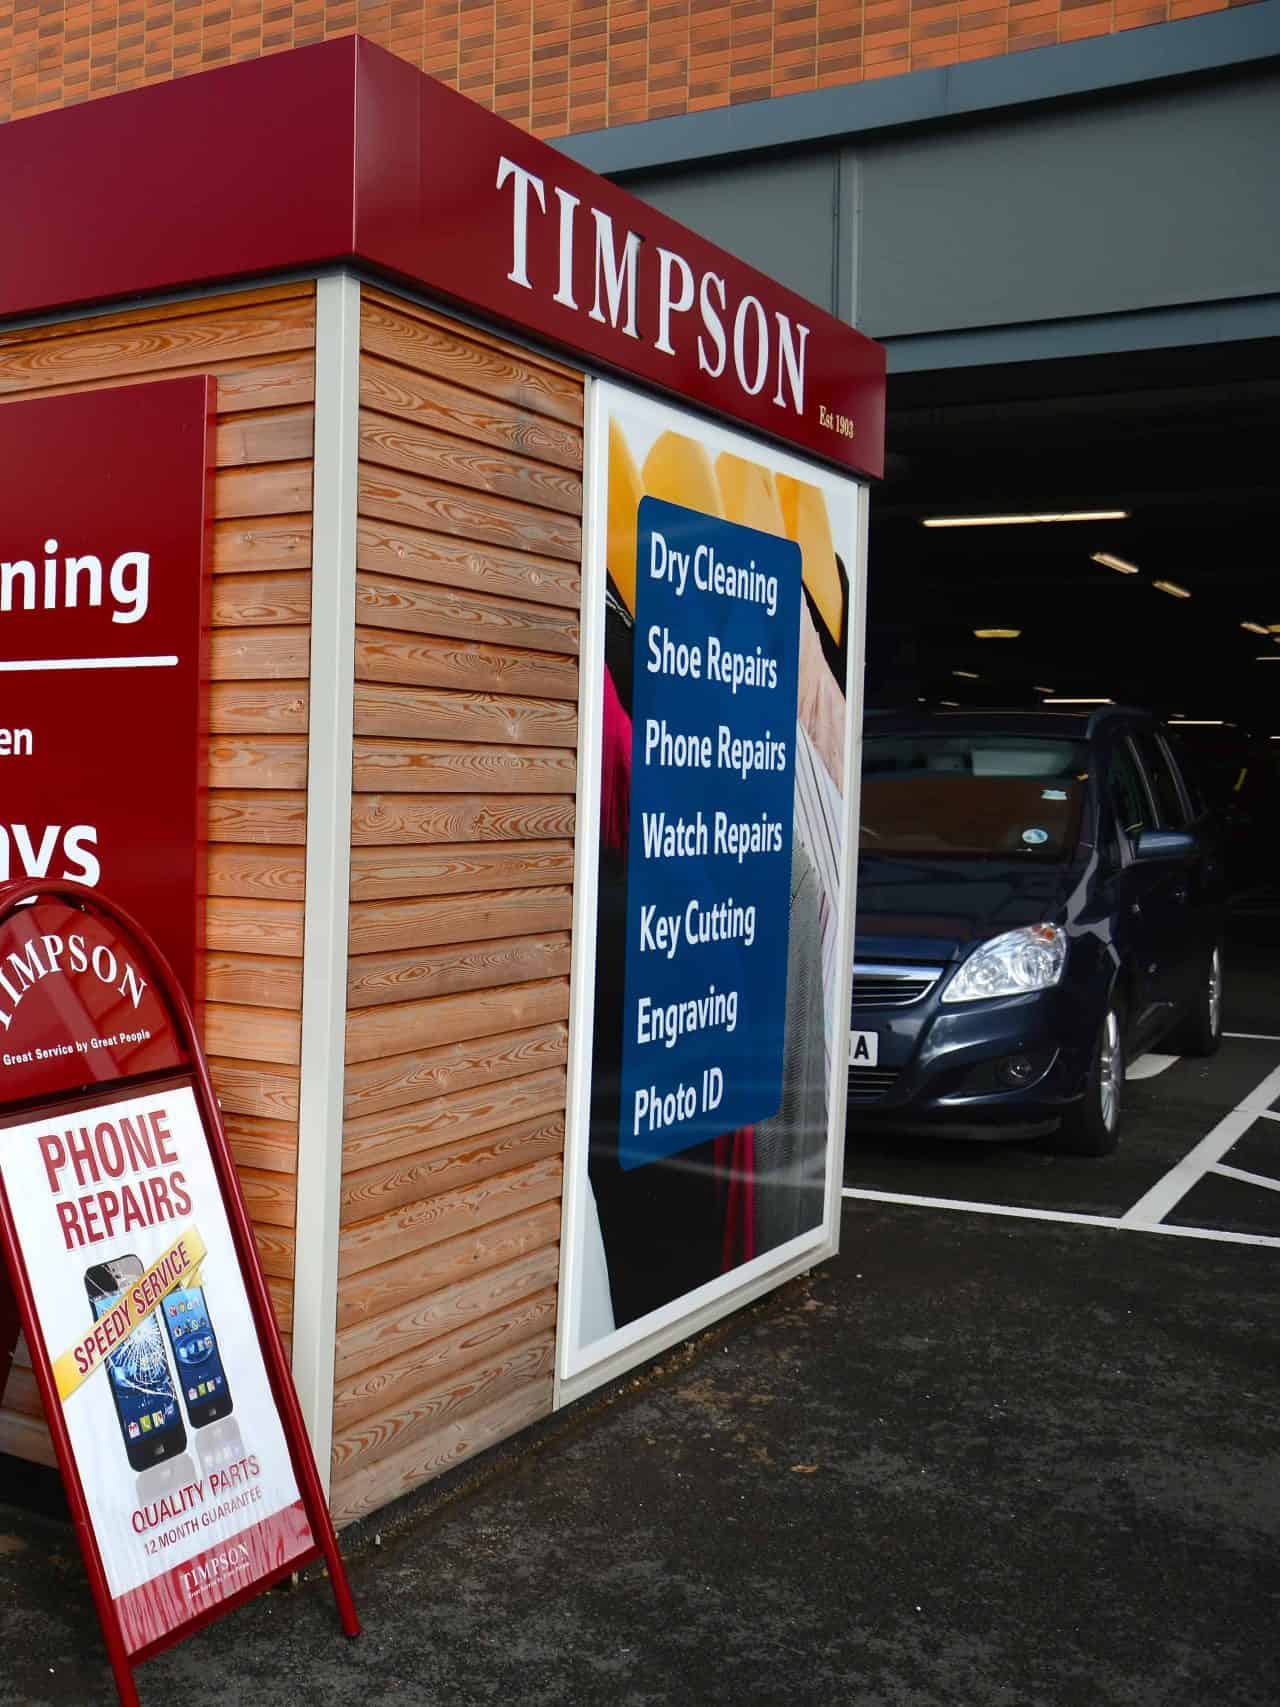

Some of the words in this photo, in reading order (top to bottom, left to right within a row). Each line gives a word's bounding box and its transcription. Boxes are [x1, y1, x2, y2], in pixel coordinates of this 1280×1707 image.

[496, 156, 810, 416] TIMPSON
[819, 405, 833, 429] Est
[835, 414, 854, 439] 1903
[650, 532, 688, 596] Dry
[694, 545, 778, 616] Cleaning
[647, 625, 701, 679] Shoe
[707, 636, 778, 693] Repairs
[645, 719, 712, 768] Phone
[718, 726, 786, 779] Repairs
[642, 812, 708, 859] Watch
[714, 812, 782, 863] Repairs
[640, 905, 681, 958] Key
[685, 897, 756, 947] Cutting
[3, 1053, 33, 1066] Great
[36, 1045, 74, 1060] Service
[76, 1040, 89, 1053] by
[91, 1036, 118, 1049] Great
[119, 1029, 151, 1045] People
[637, 986, 738, 1049] Engraving
[849, 1035, 869, 1060] A
[633, 1077, 697, 1135] Photo
[703, 1067, 723, 1113] ID
[38, 1109, 178, 1195] PHONE
[56, 1171, 192, 1251] REPAIRS
[72, 1299, 129, 1374] SPEEDY
[132, 1241, 191, 1315] SERVICE
[131, 1480, 205, 1534] QUALITY
[210, 1455, 260, 1492] PARTS
[144, 1538, 158, 1556] 12
[157, 1518, 199, 1552] MONTH
[201, 1485, 263, 1528] GUARANTEE
